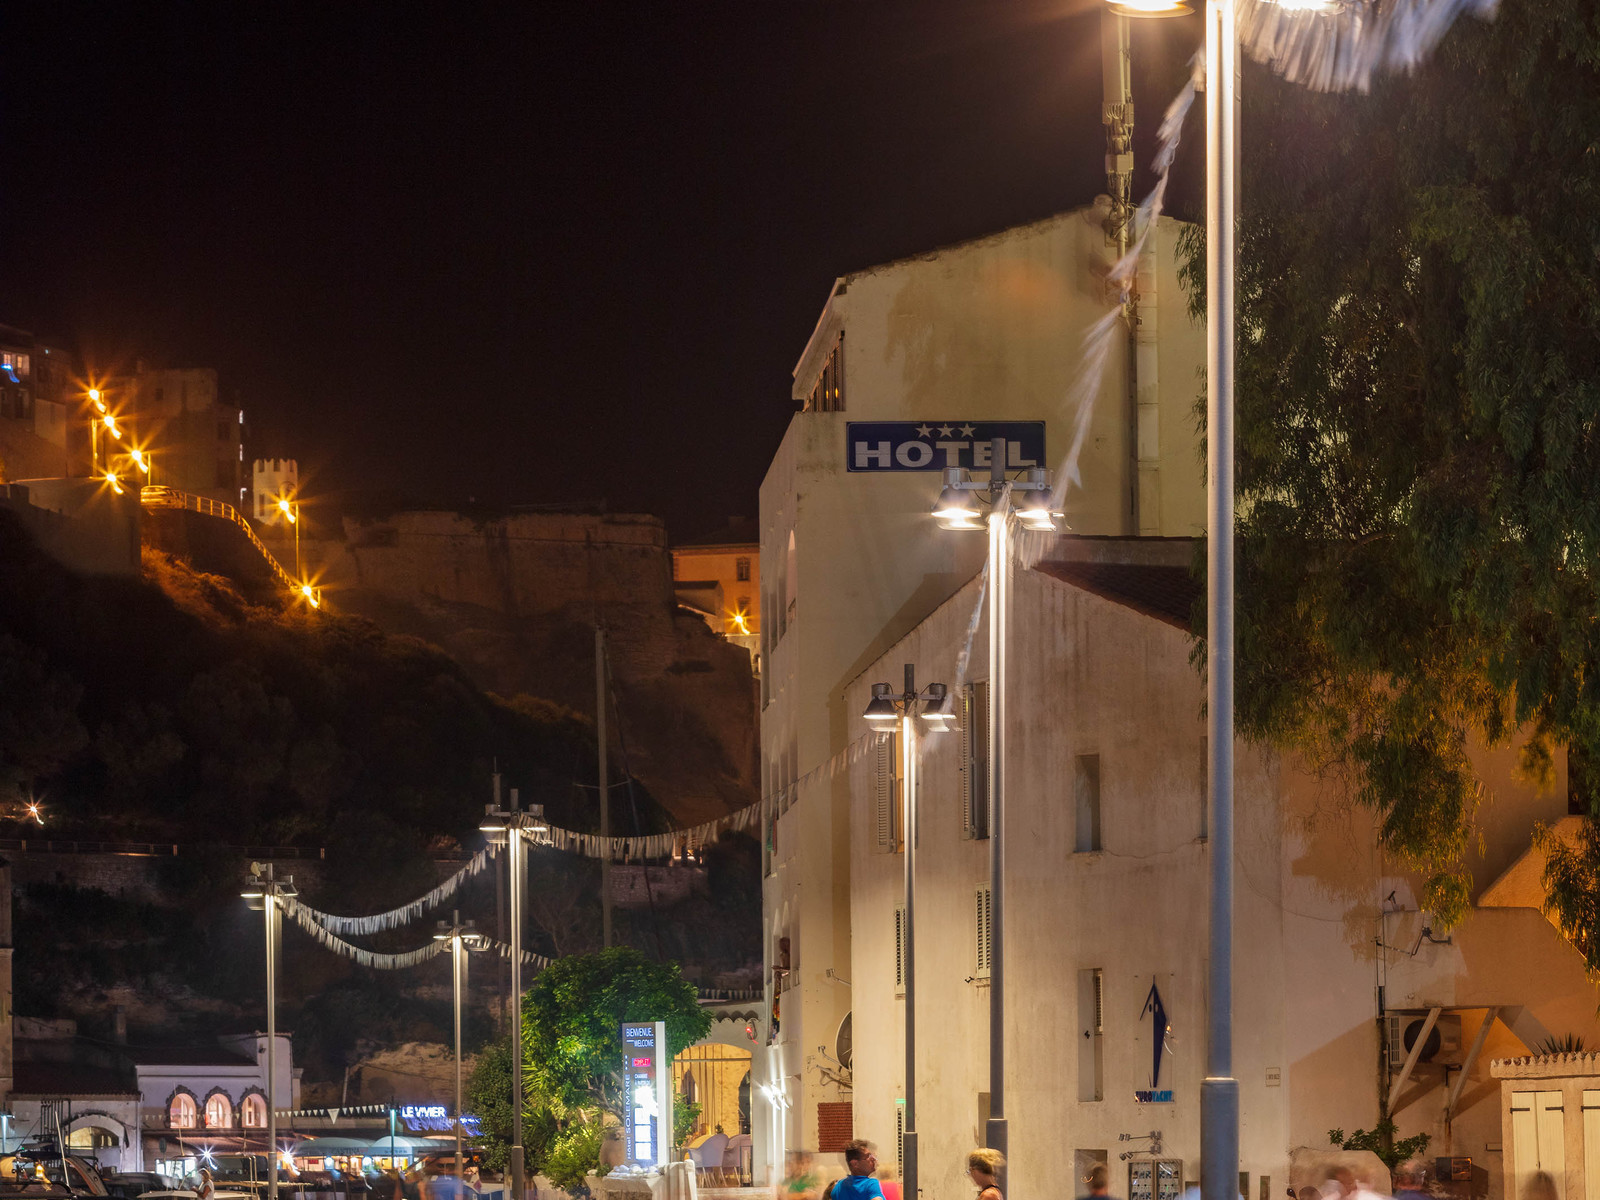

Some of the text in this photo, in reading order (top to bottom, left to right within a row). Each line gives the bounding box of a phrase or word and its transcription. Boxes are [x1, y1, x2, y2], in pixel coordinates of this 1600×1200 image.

[855, 441, 1037, 467] HOTEL
[634, 1039, 654, 1047] WELCOME
[401, 1106, 446, 1118] LE VIVIER
